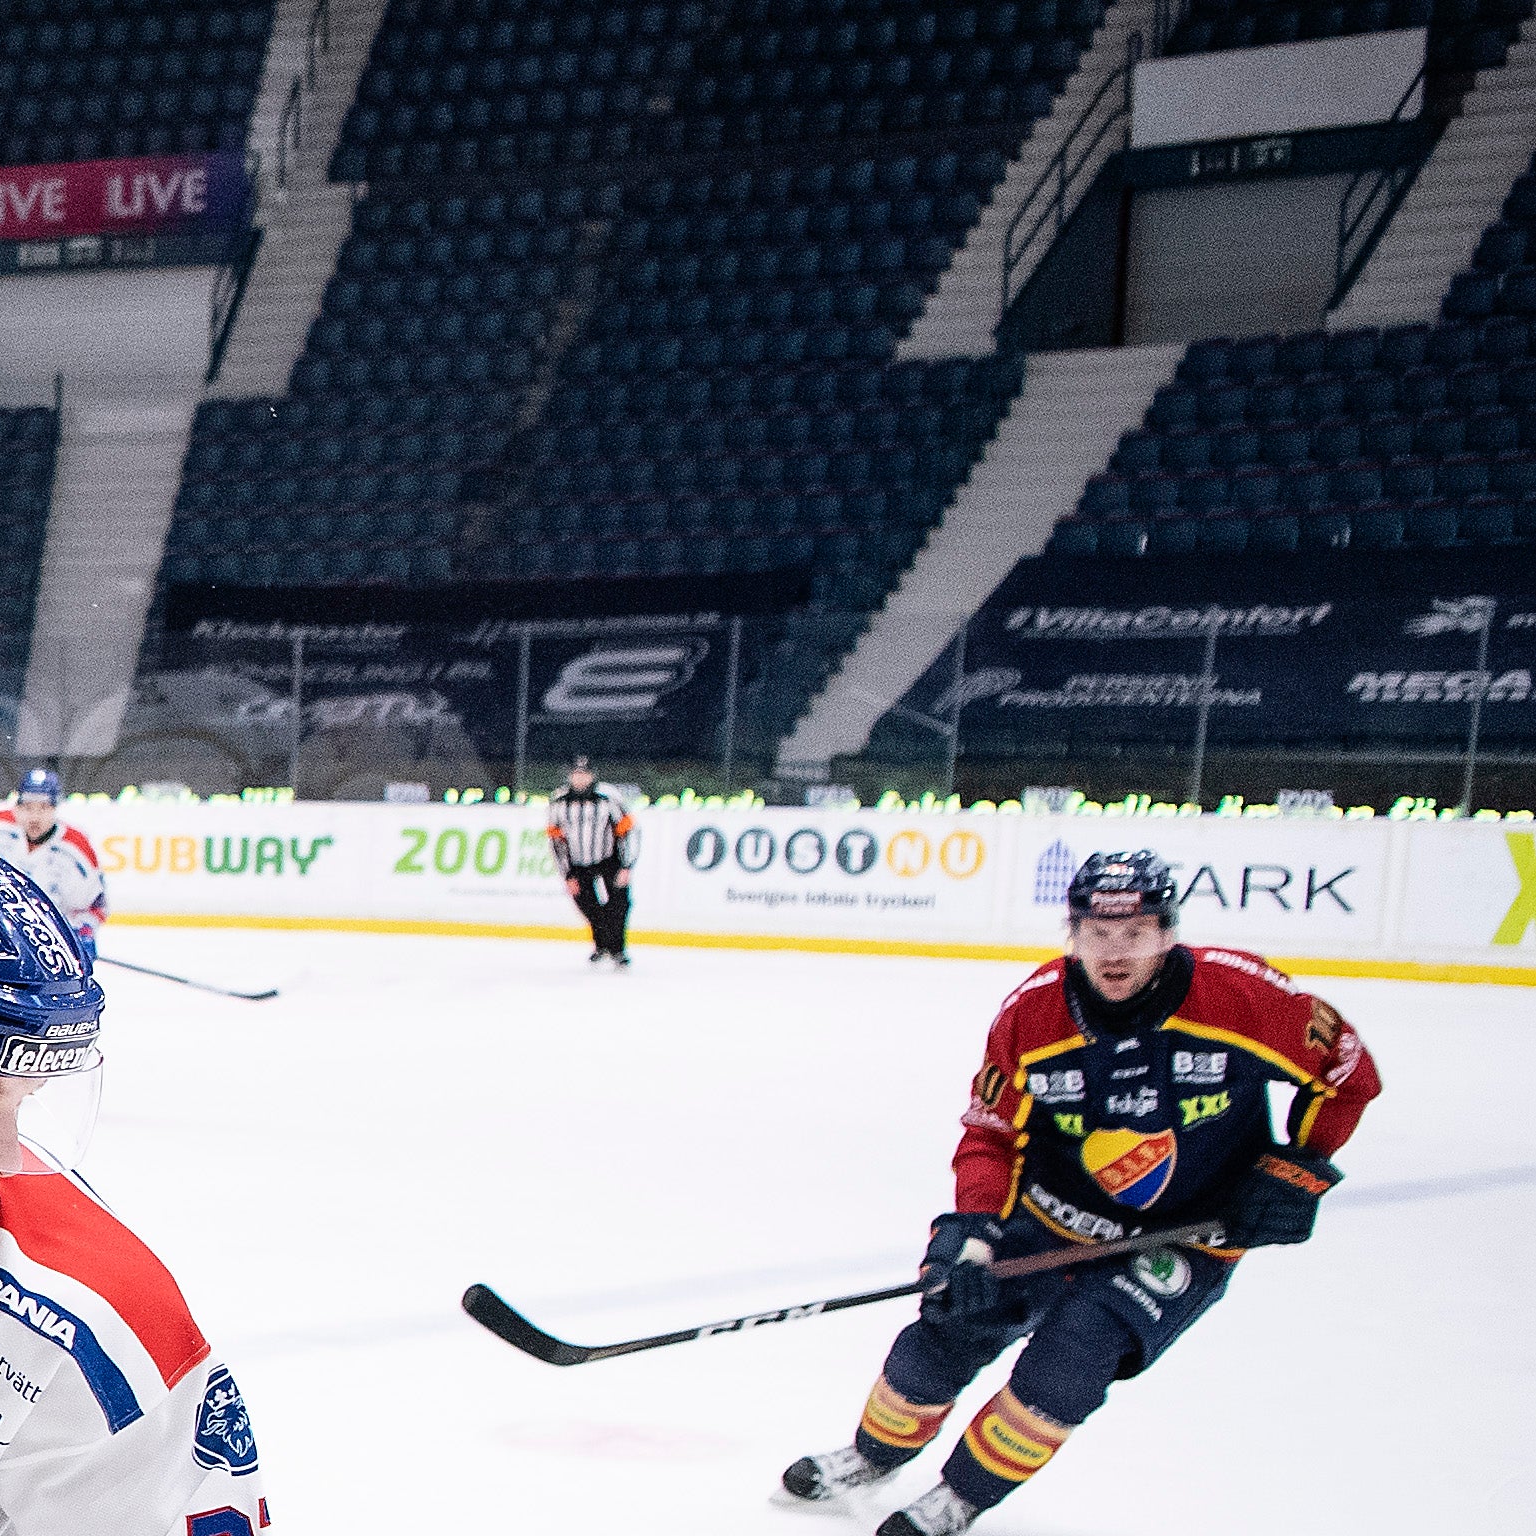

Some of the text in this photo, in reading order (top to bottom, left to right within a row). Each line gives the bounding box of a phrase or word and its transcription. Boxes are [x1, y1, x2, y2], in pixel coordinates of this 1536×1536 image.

[103, 168, 209, 220] LIVE
[101, 833, 331, 878] SUBWAY
[393, 827, 509, 877] 200
